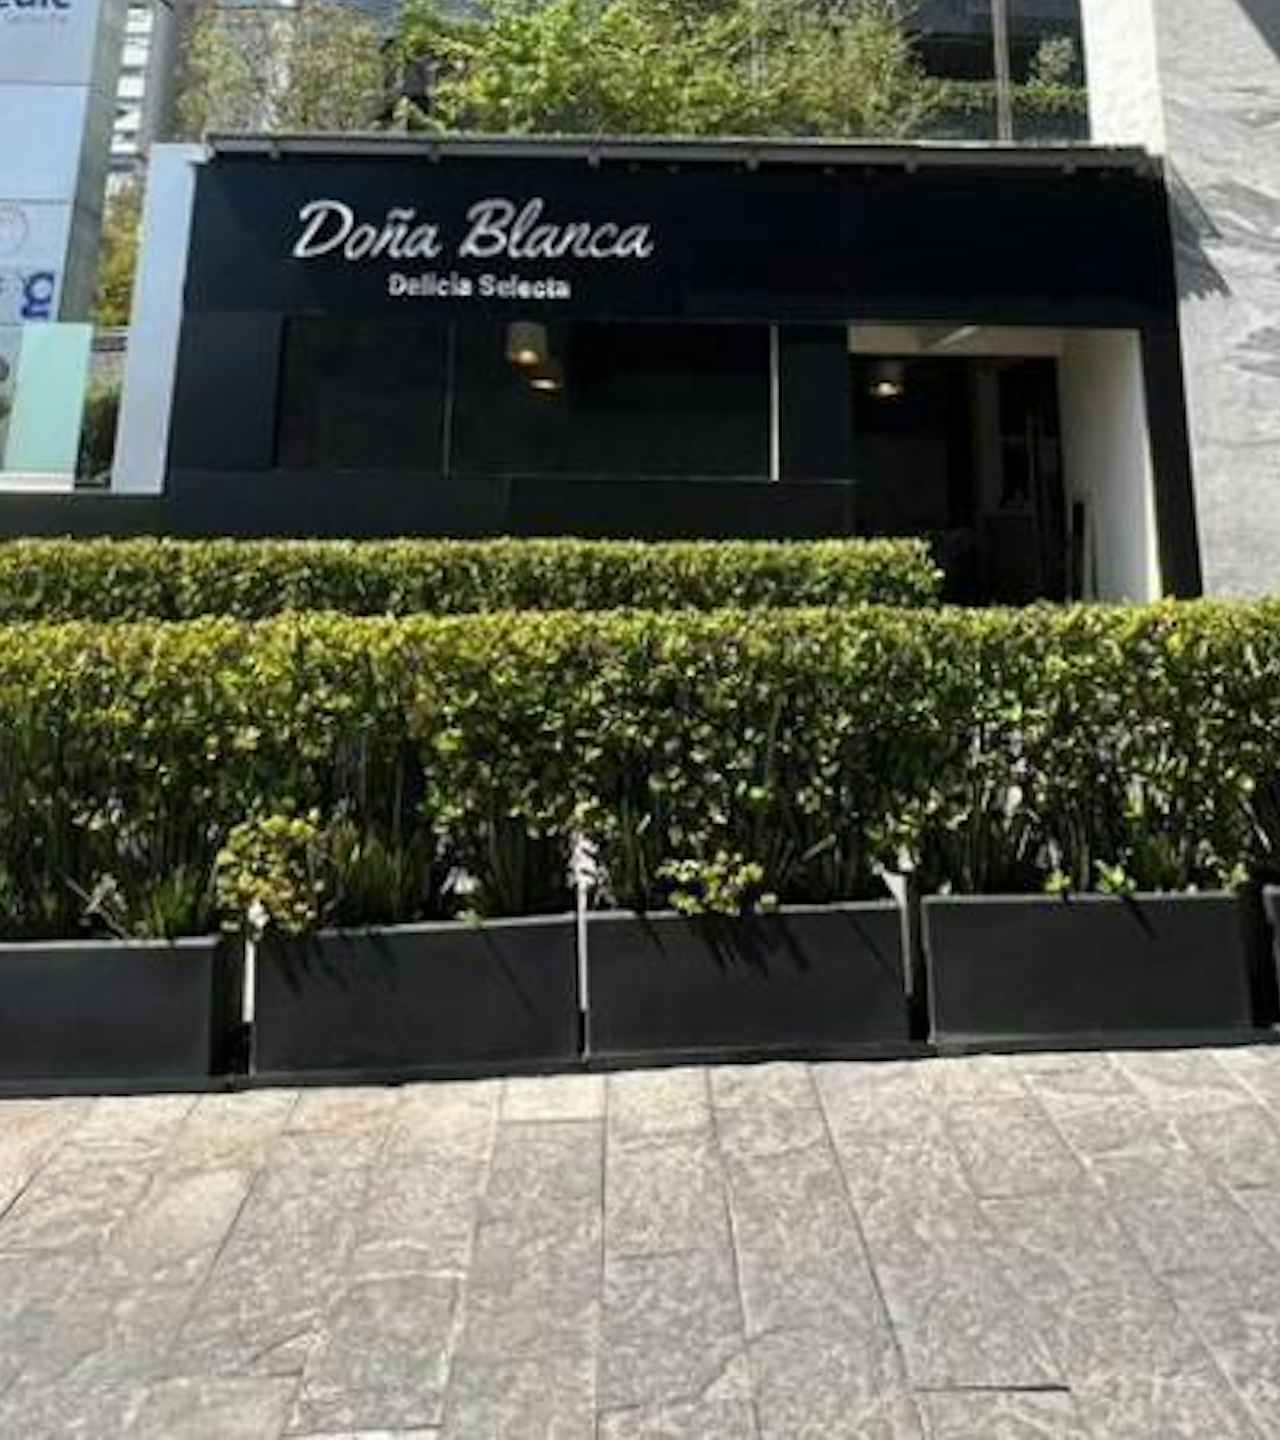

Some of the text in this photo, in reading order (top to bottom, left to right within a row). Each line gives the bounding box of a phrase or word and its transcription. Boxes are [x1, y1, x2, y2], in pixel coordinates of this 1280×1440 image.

[293, 197, 655, 260] Doña Blanca
[388, 271, 571, 300] Delicia Selecta
